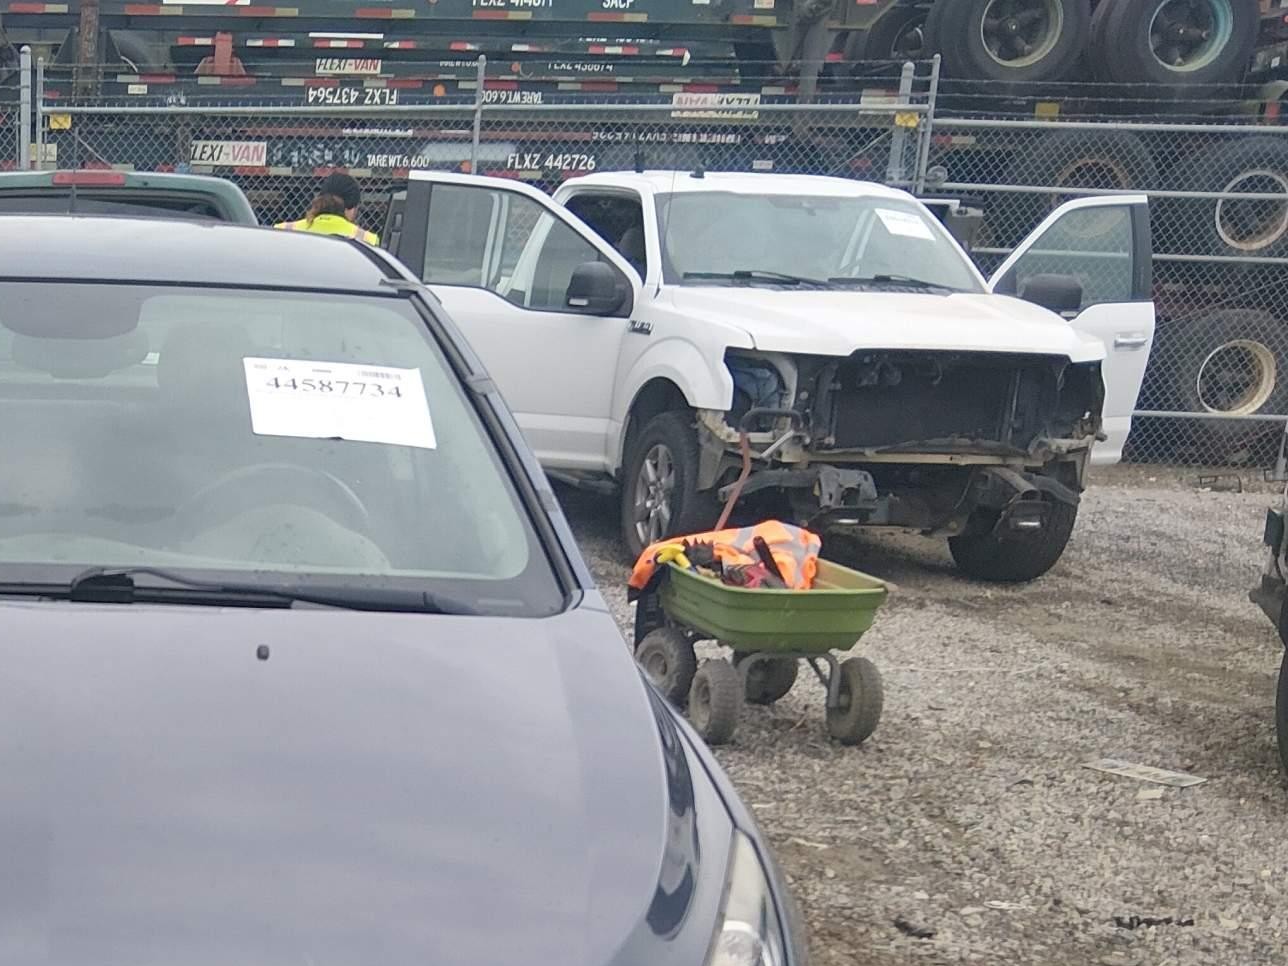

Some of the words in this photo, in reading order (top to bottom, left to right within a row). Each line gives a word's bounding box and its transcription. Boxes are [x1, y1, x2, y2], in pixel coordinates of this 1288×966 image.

[317, 59, 378, 71] FLEXI-VAN
[307, 86, 360, 104] 437564
[364, 87, 398, 105] FLXZ
[367, 153, 388, 168] TARE
[507, 153, 541, 169] FLXZ
[544, 153, 596, 171] 442726
[265, 376, 404, 399] 44587734
